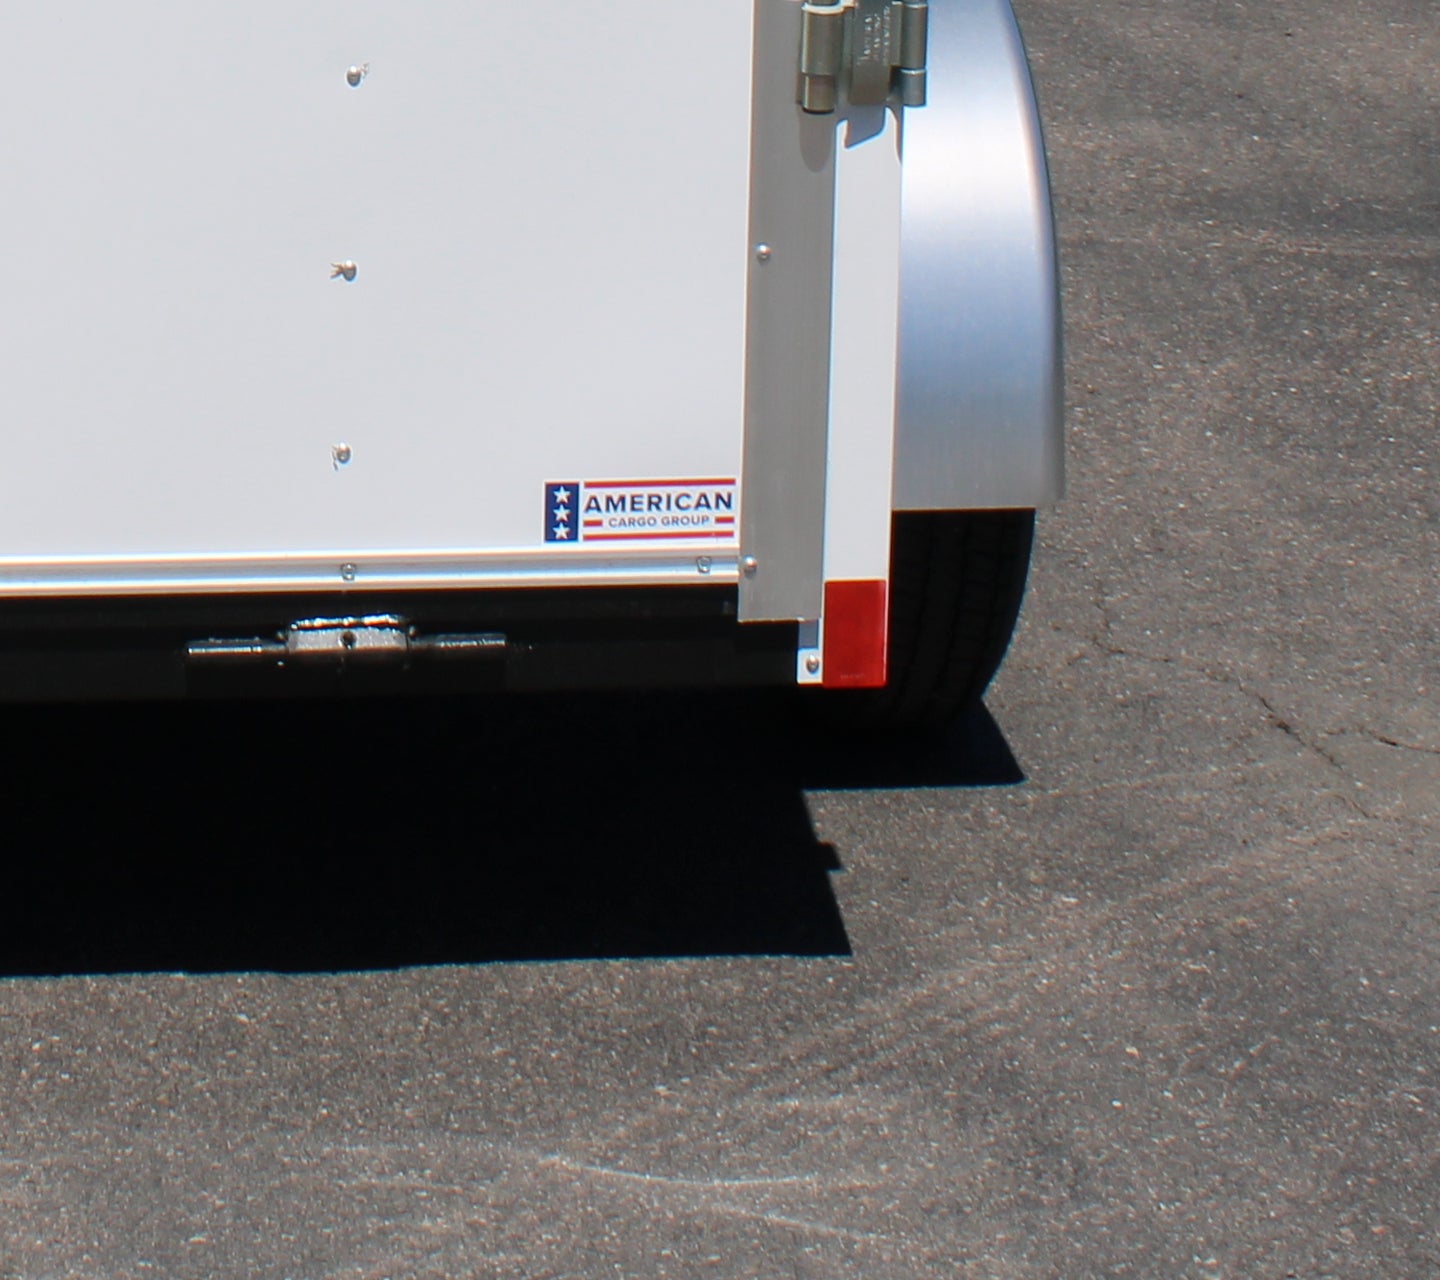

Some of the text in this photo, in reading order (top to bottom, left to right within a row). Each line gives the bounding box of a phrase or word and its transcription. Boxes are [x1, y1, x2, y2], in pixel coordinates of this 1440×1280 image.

[585, 492, 733, 513] AMERICAN
[608, 514, 710, 528] CARGO GROUP
